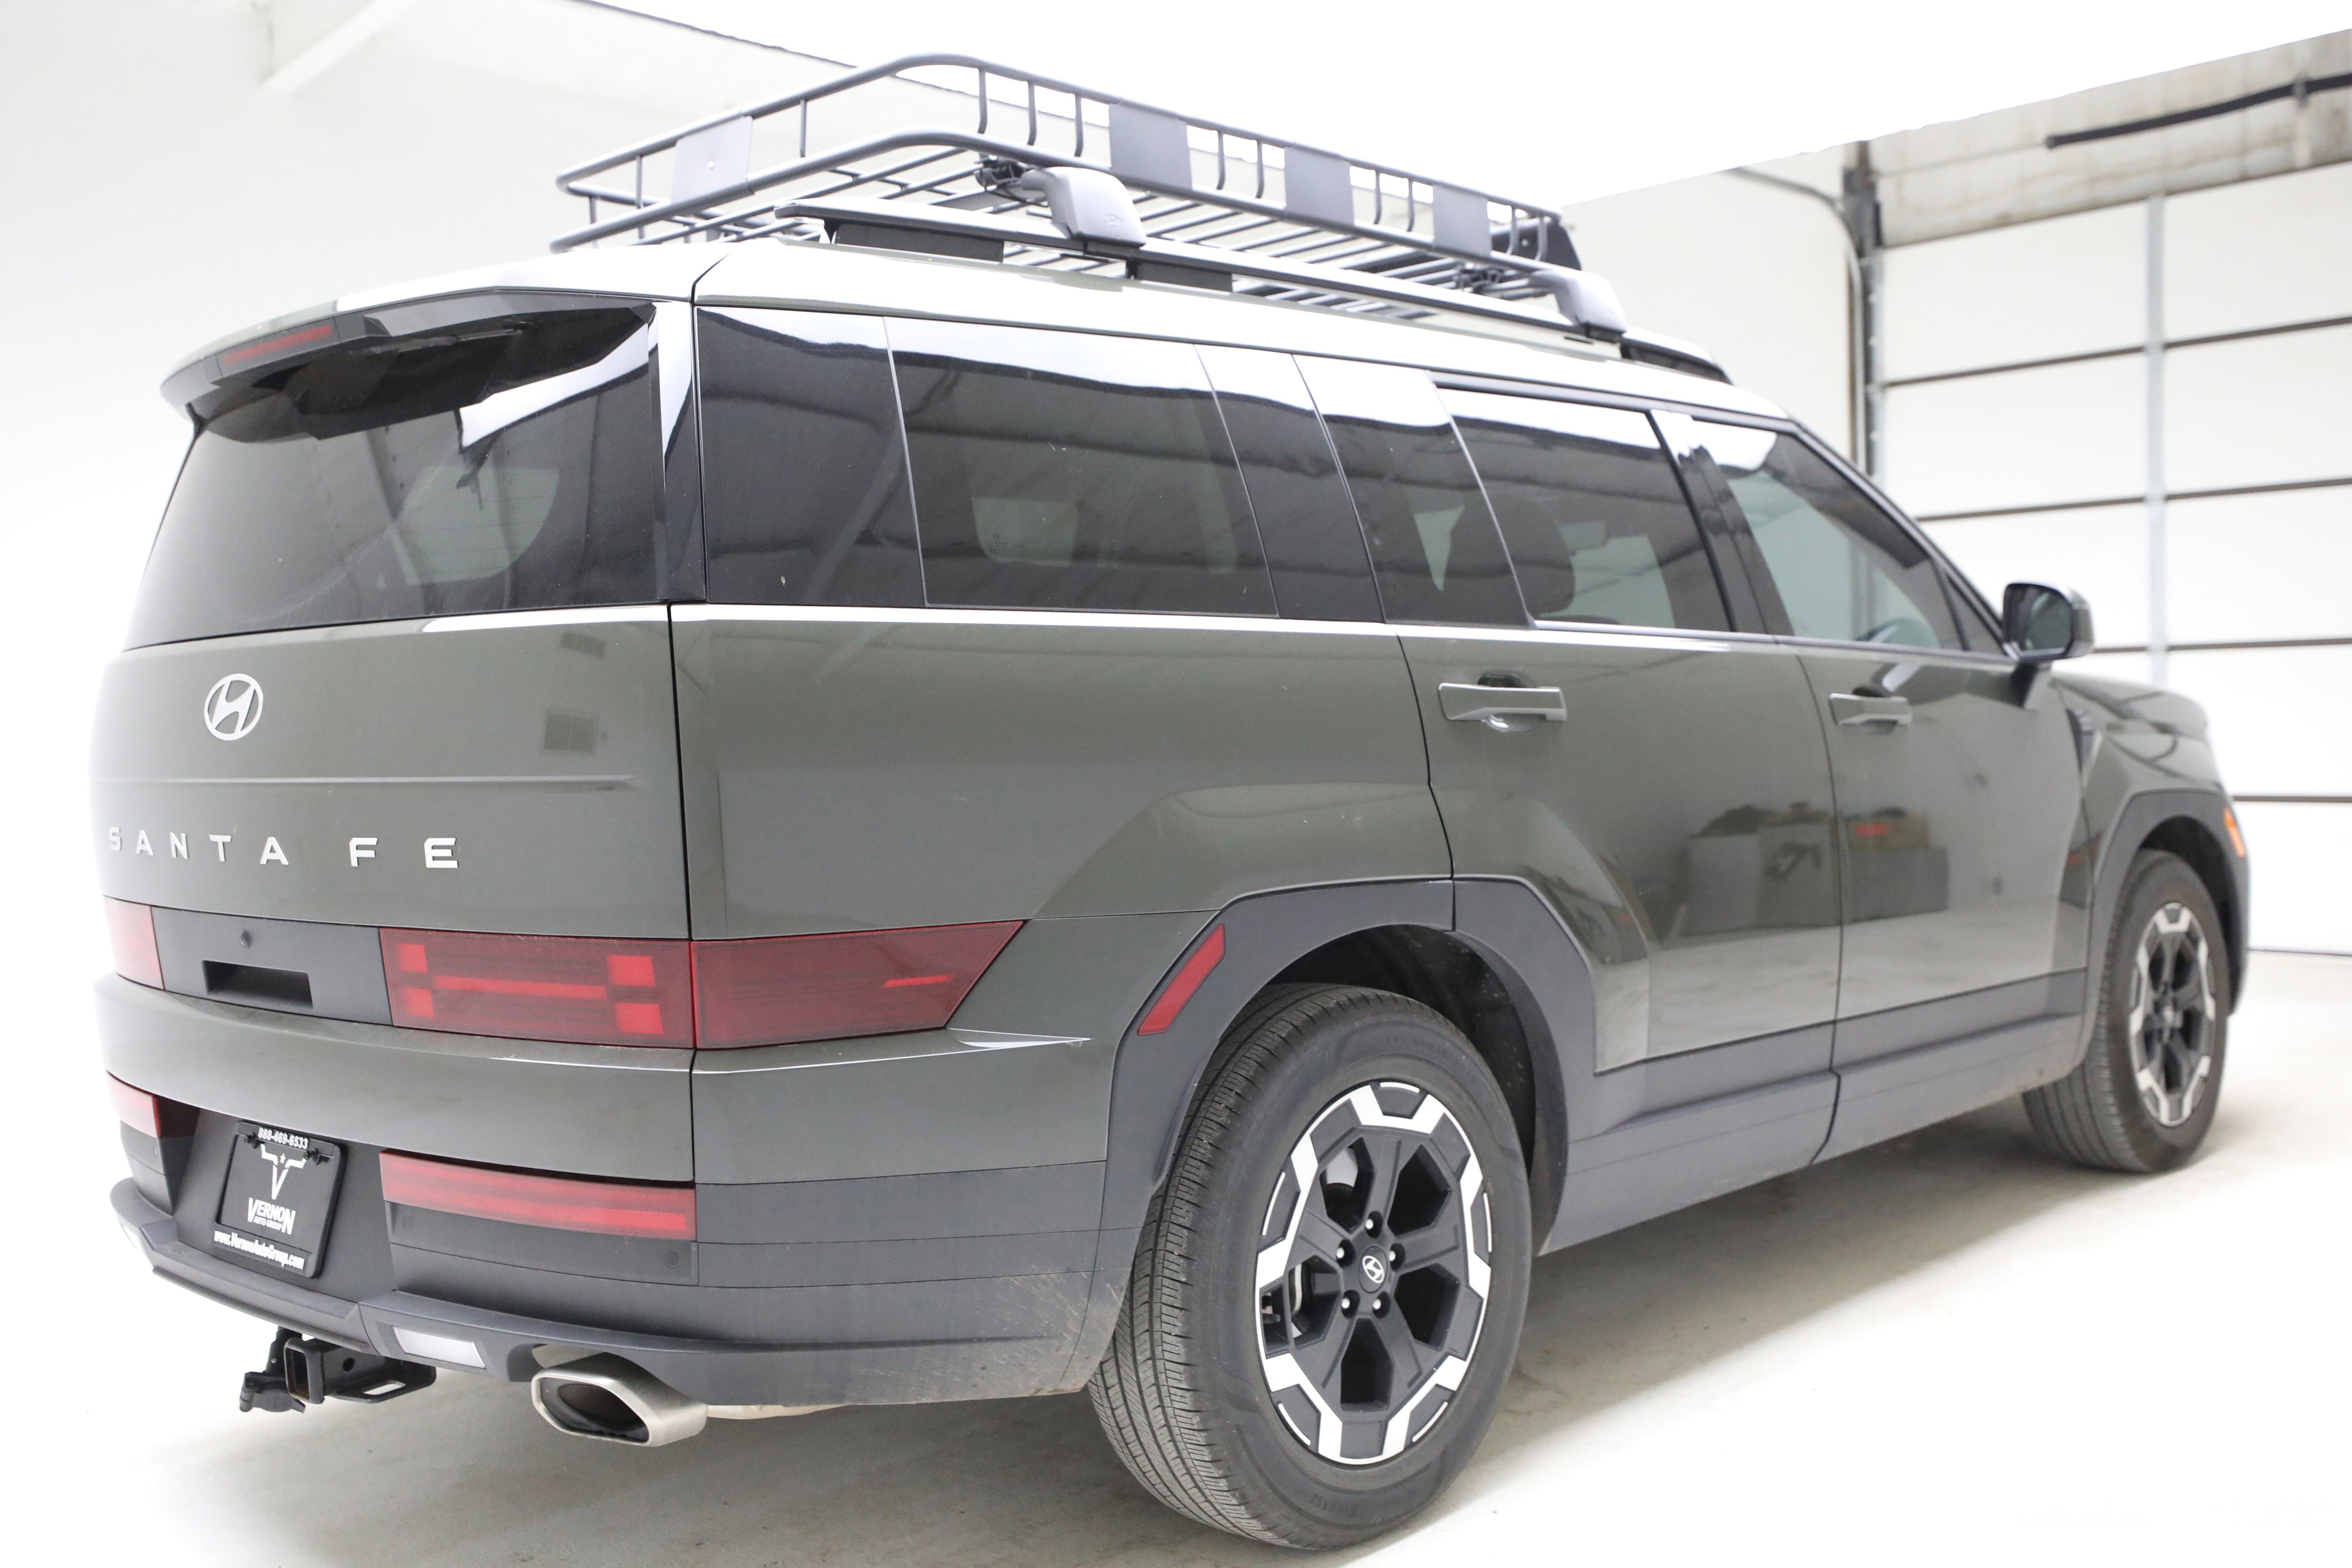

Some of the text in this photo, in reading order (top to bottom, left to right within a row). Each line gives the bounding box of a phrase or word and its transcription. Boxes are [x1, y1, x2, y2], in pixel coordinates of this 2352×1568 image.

[109, 826, 459, 869] SANTA FE
[258, 1127, 308, 1150] 888-469-6533
[247, 1197, 296, 1235] VERNON
[214, 1230, 304, 1270] www.VernonAutoGroup.com
